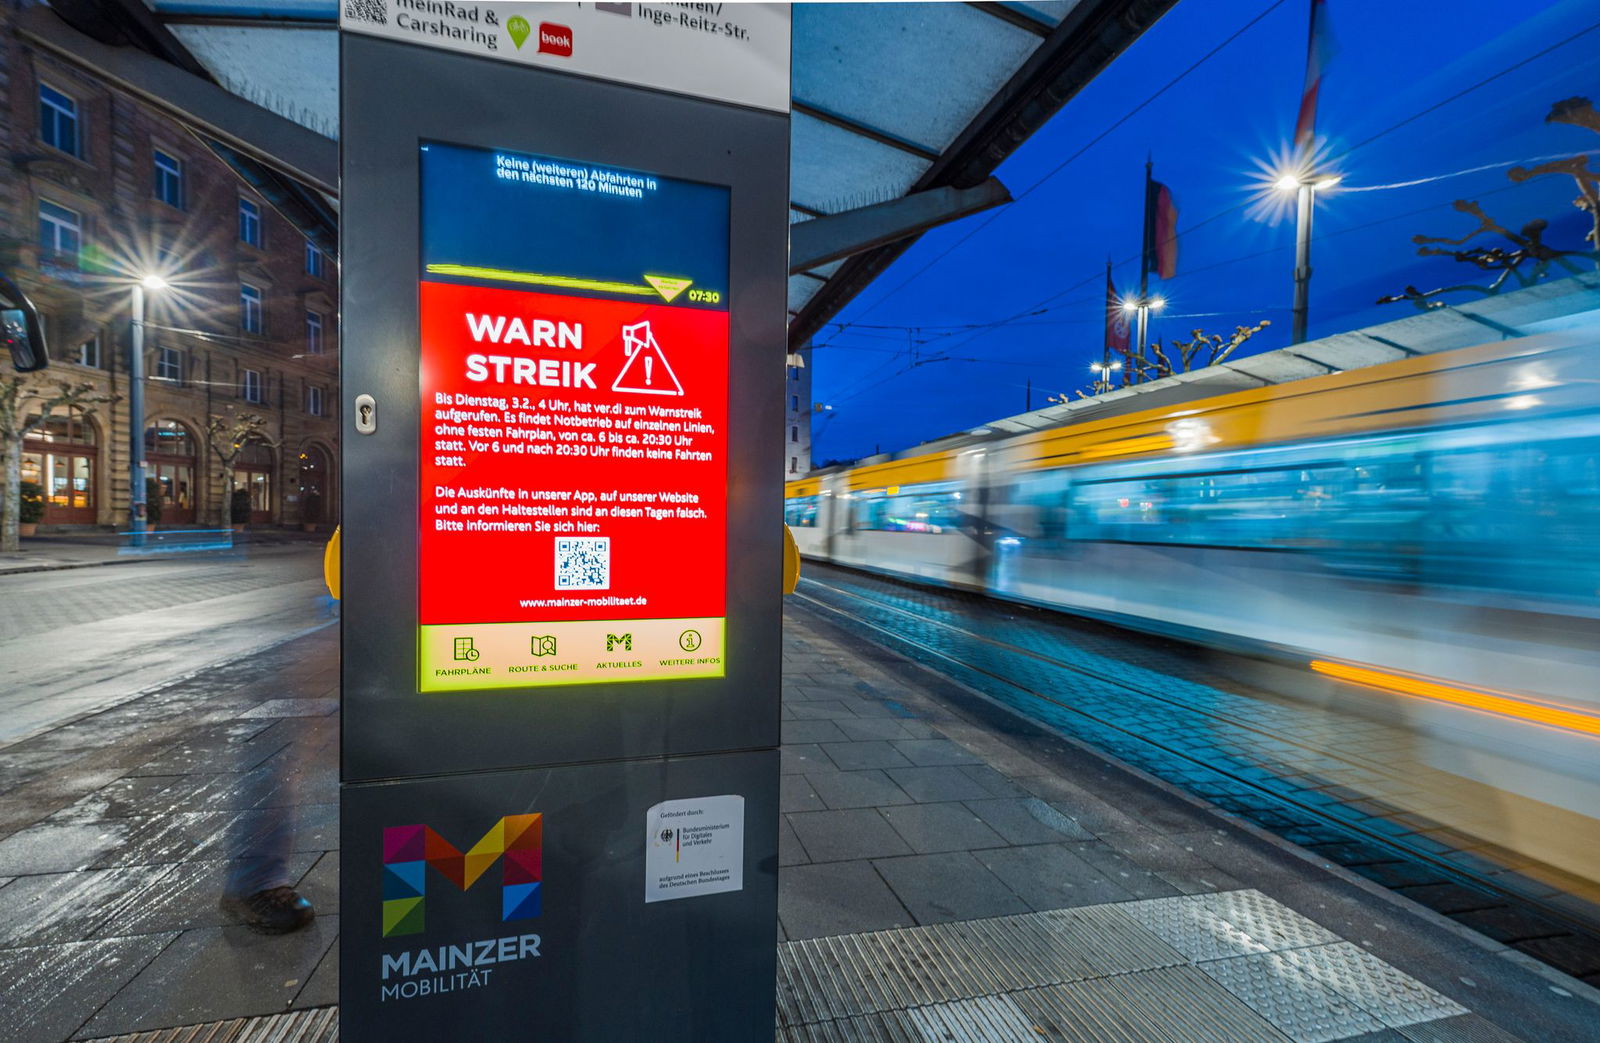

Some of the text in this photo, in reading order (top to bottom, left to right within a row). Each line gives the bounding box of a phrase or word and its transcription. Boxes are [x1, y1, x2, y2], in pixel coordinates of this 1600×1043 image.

[485, 10, 499, 26] &
[639, 5, 750, 41] Inge-Reitz-Str.
[396, 13, 498, 50] Carsharing
[542, 30, 570, 48] book
[496, 155, 657, 190] Keine (weiteren) Abfahrten in
[496, 168, 519, 180] den
[522, 170, 574, 188] nächsten
[598, 180, 642, 198] Minuten
[689, 290, 719, 303] 07:30
[466, 313, 582, 349] WARN
[466, 354, 596, 389] STREIK
[435, 392, 702, 418] Bis Dienstag, 3.2., 4 Uhr, hat ver.di zum Warnstreik
[435, 408, 714, 434] aufgerufen. Es findet Notbetrieb auf einzelnen Linien,
[435, 424, 693, 446] ohne festen Fahrplan, von ca. 6 bis ca. 20:30 Uhr
[435, 440, 712, 461] statt. Vor 6 und nach 20:30 Uhr finden keine Fahrten
[435, 456, 466, 466] statt.
[435, 486, 699, 503] Die Auskünfte in unserer App, auf unserer Website
[435, 503, 707, 520] und an den Haltestellen sind an diesen Tagen falsch.
[435, 520, 600, 532] Bitte informieren Sie sich hier:
[520, 596, 647, 607] www.mainzer-mobilitaet.de
[436, 666, 492, 676] FAHRPLÄNE
[509, 665, 539, 673] ROUTE
[596, 660, 642, 669] AKTUELLES
[660, 658, 694, 666] WEITERE
[382, 934, 541, 980] MAINZER
[381, 968, 492, 1002] MOBILITÄT
